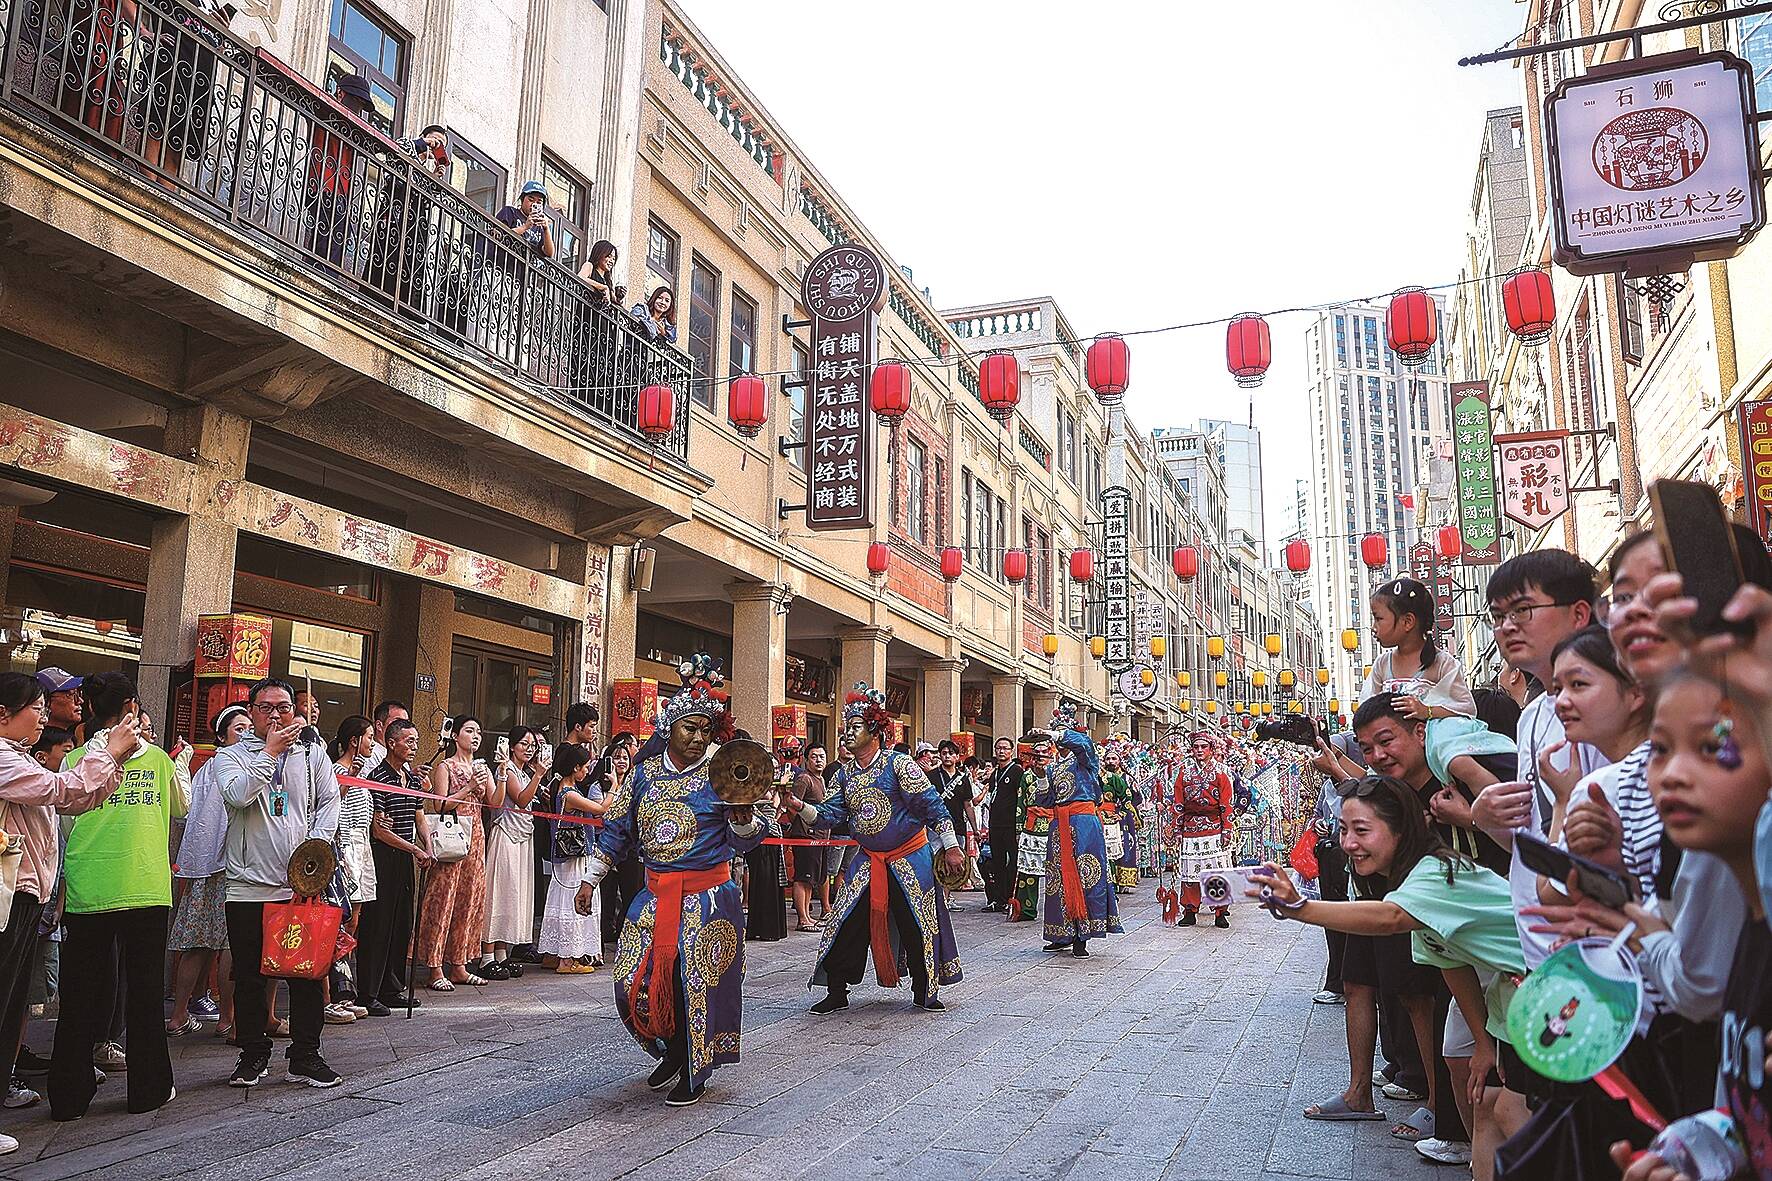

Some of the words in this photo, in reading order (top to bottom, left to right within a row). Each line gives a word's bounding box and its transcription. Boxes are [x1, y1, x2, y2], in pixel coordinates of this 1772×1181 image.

[1614, 79, 1674, 107] 石狮
[1571, 187, 1746, 231] 中国灯谜艺术之乡
[1591, 229, 1616, 237] ZHONG
[1617, 226, 1632, 235] GUO
[1633, 224, 1653, 232] DENG
[1672, 219, 1687, 227] SHU
[1688, 217, 1701, 226] ZHI
[1702, 214, 1726, 224] XIANG
[844, 253, 875, 289] QUAN
[825, 292, 869, 317] ZHOU
[815, 337, 838, 509] 有街无处不经商
[837, 332, 861, 508] 铺天盖地万式装
[1520, 462, 1551, 517] 彩扎
[1550, 474, 1563, 497] 不包
[1108, 501, 1125, 659] 爱拼敢赢输赢笑笑
[234, 629, 266, 667] 福
[583, 555, 606, 711] 共产党的恩
[100, 790, 161, 809] 年志愿
[281, 923, 303, 950] 福
